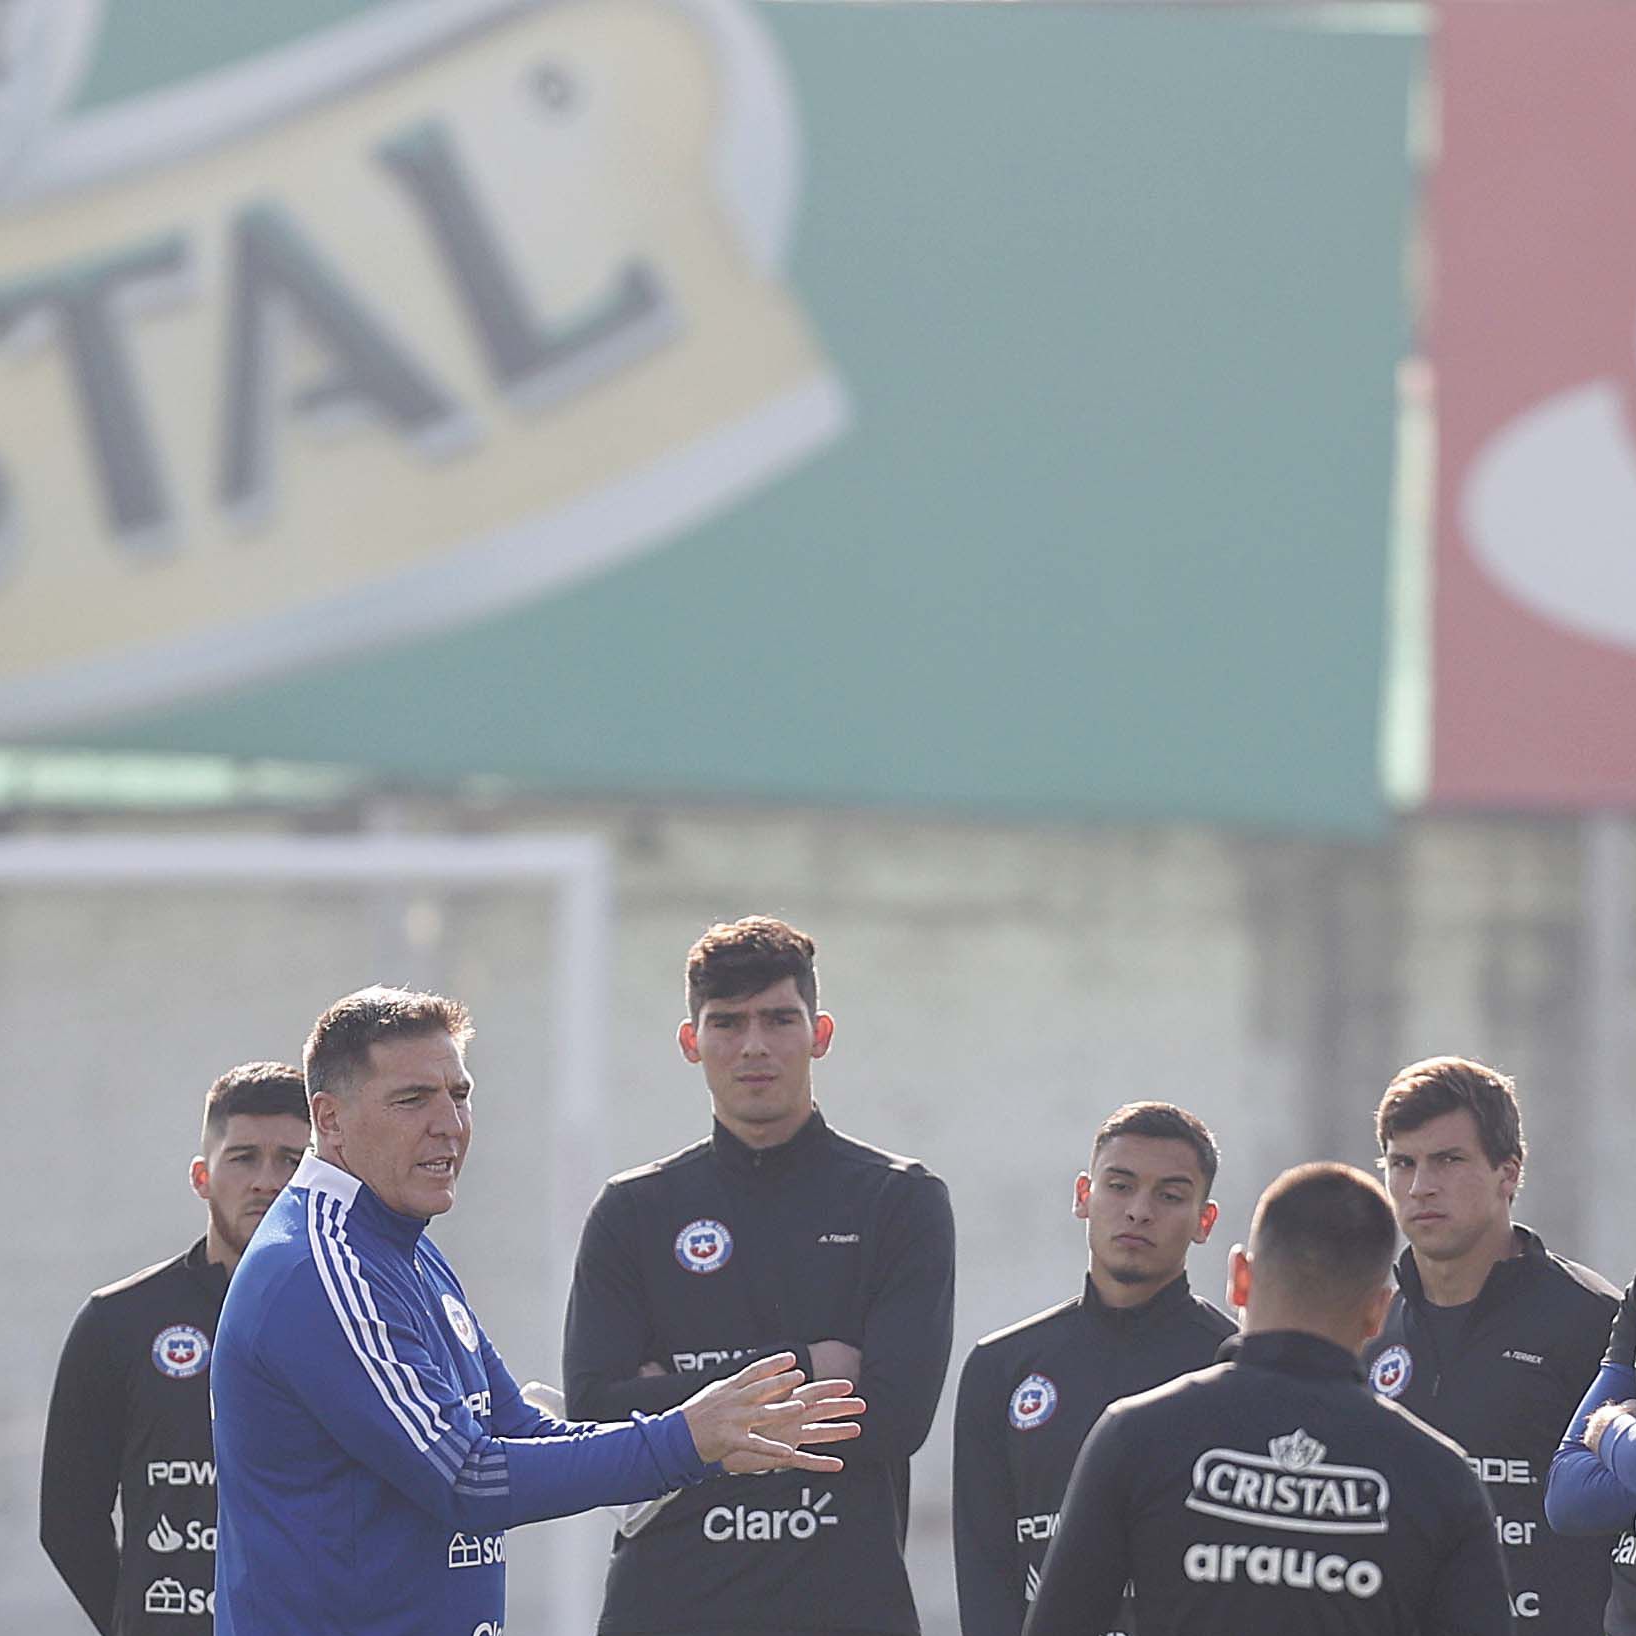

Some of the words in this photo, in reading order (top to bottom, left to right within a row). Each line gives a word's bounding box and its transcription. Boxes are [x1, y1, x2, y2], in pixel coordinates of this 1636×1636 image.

[1205, 1467, 1373, 1517] CRISTAL
[702, 1505, 817, 1540] Claro
[1183, 1542, 1383, 1599] arauco
